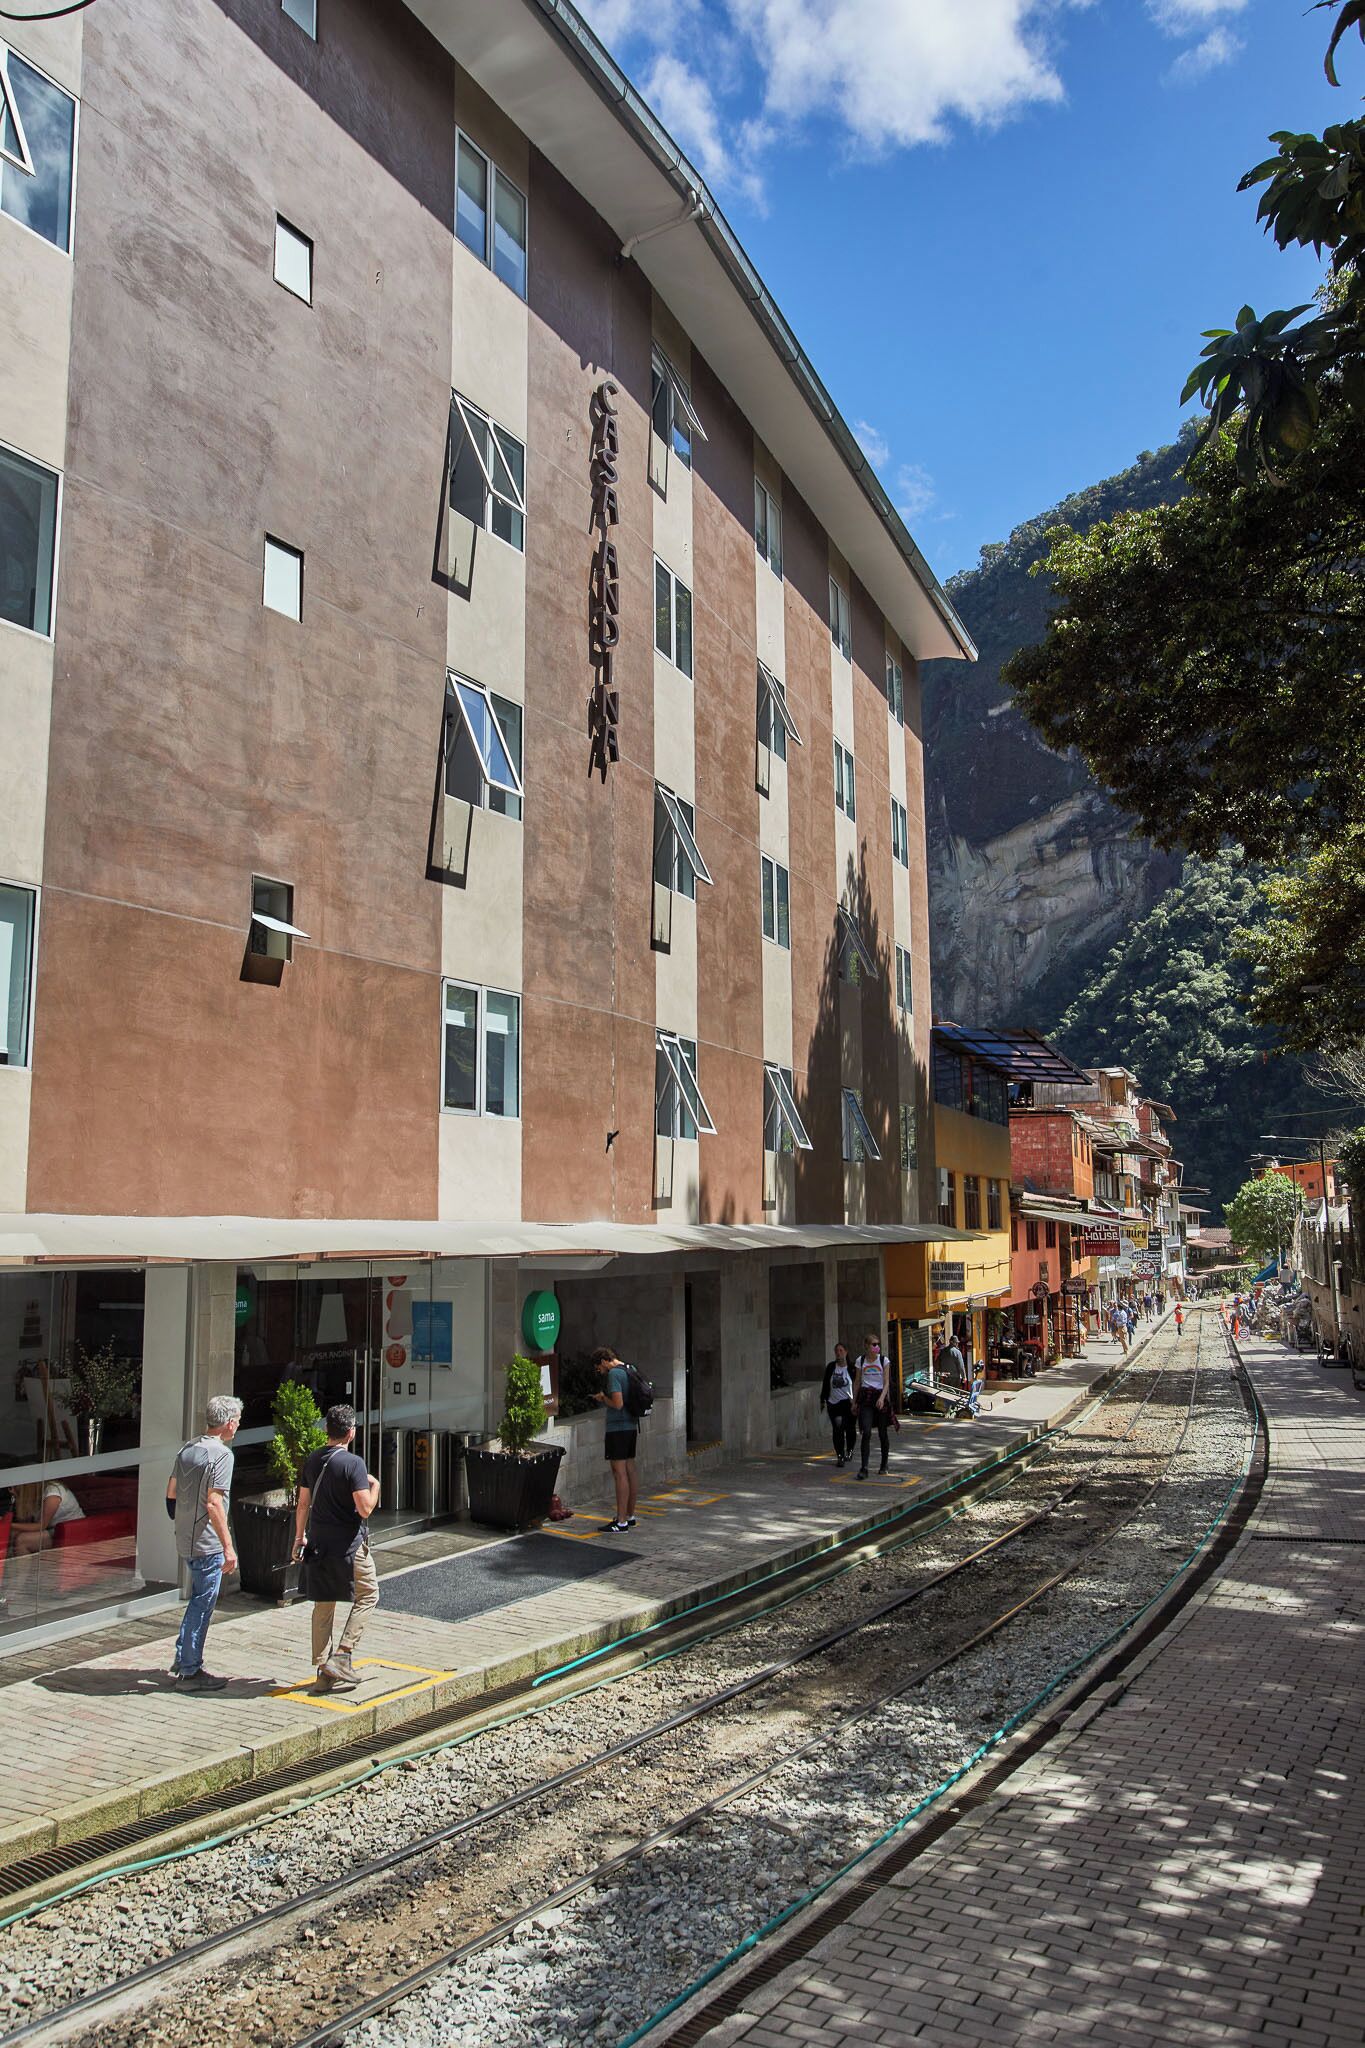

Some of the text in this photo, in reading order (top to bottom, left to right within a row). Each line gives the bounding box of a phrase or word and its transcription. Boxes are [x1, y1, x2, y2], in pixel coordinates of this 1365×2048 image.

[598, 380, 619, 762] CASA ANDINA
[1085, 1232, 1119, 1240] HOUSE
[538, 1312, 555, 1323] sama
[309, 1351, 328, 1360] CASA
